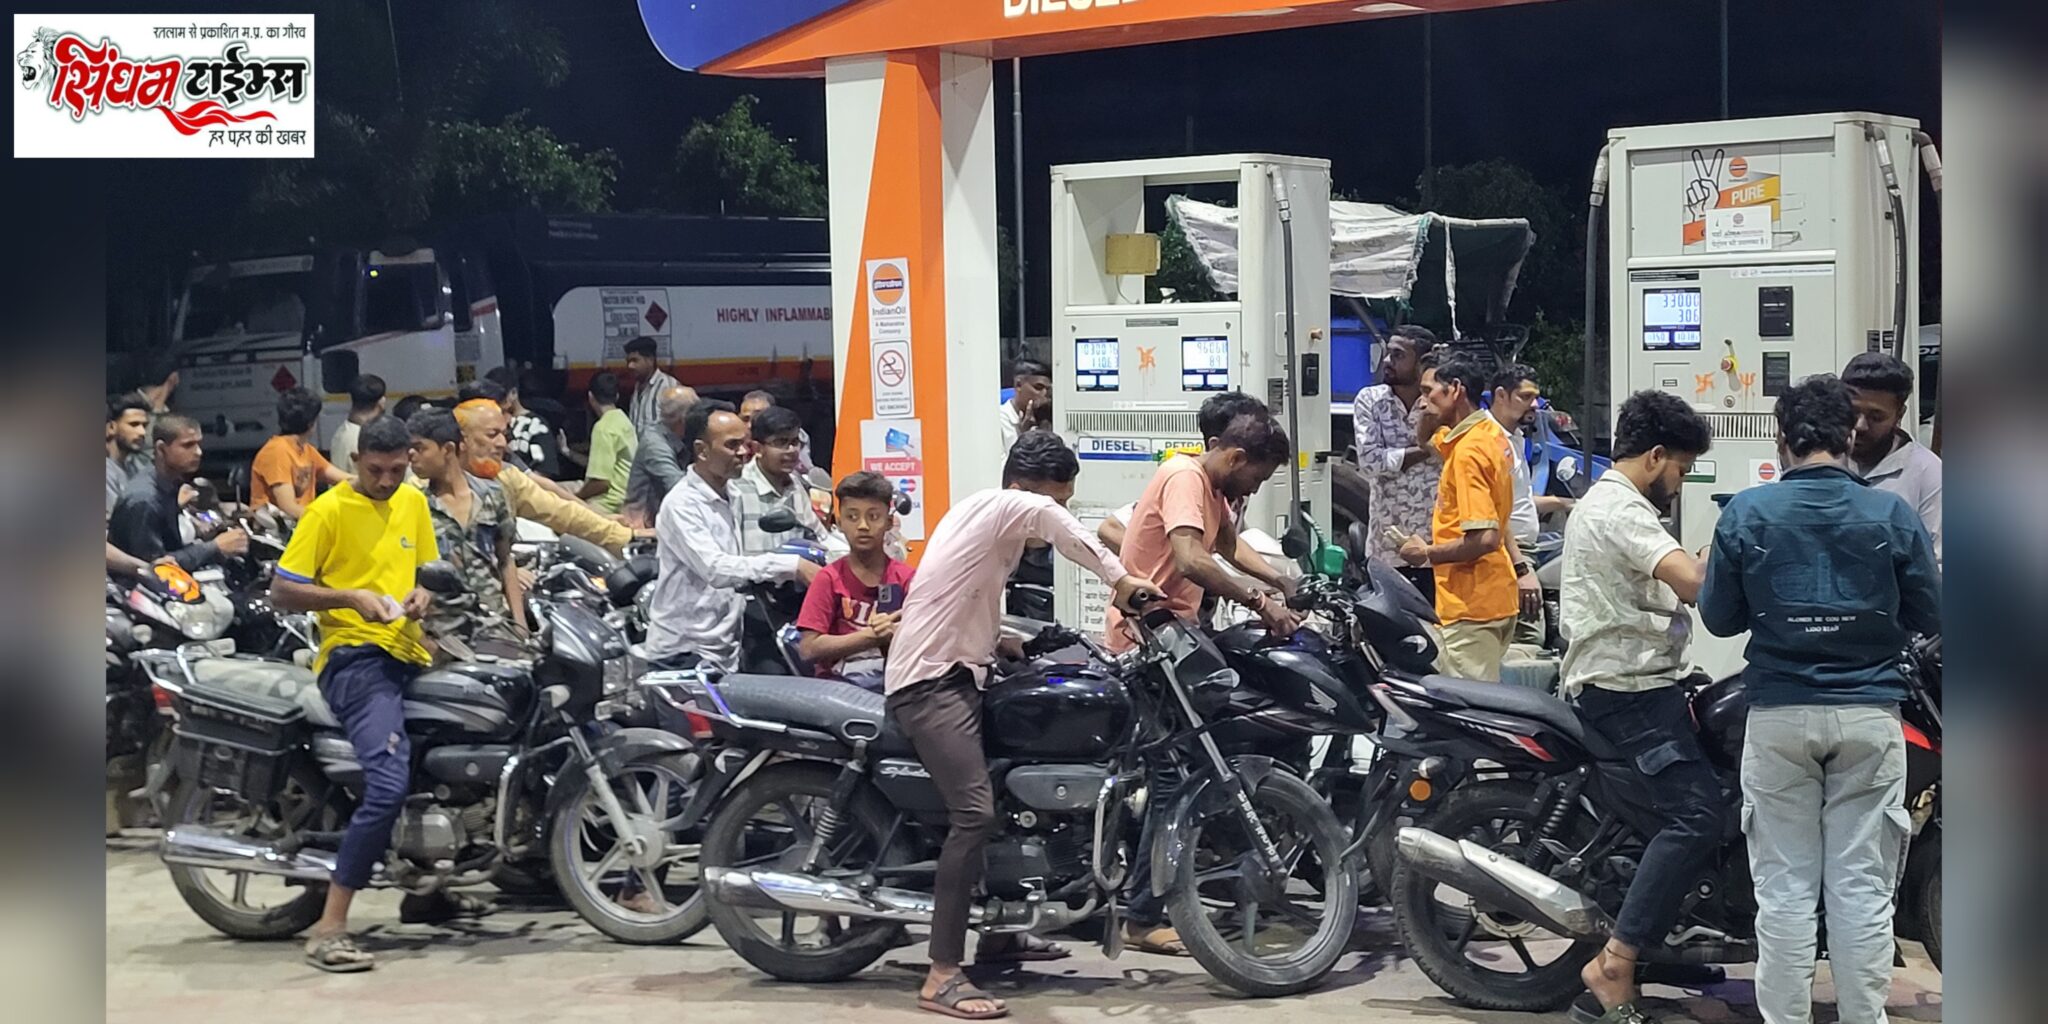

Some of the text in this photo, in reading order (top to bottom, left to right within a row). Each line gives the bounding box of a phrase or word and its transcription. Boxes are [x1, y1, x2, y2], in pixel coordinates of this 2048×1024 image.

[1731, 183, 1765, 206] PURE
[717, 307, 759, 323] HIGHLY
[872, 306, 906, 316] IndianOil
[1092, 440, 1138, 452] DIESEL
[1165, 441, 1204, 450] PETRO
[870, 461, 916, 472] WE ACCEPT
